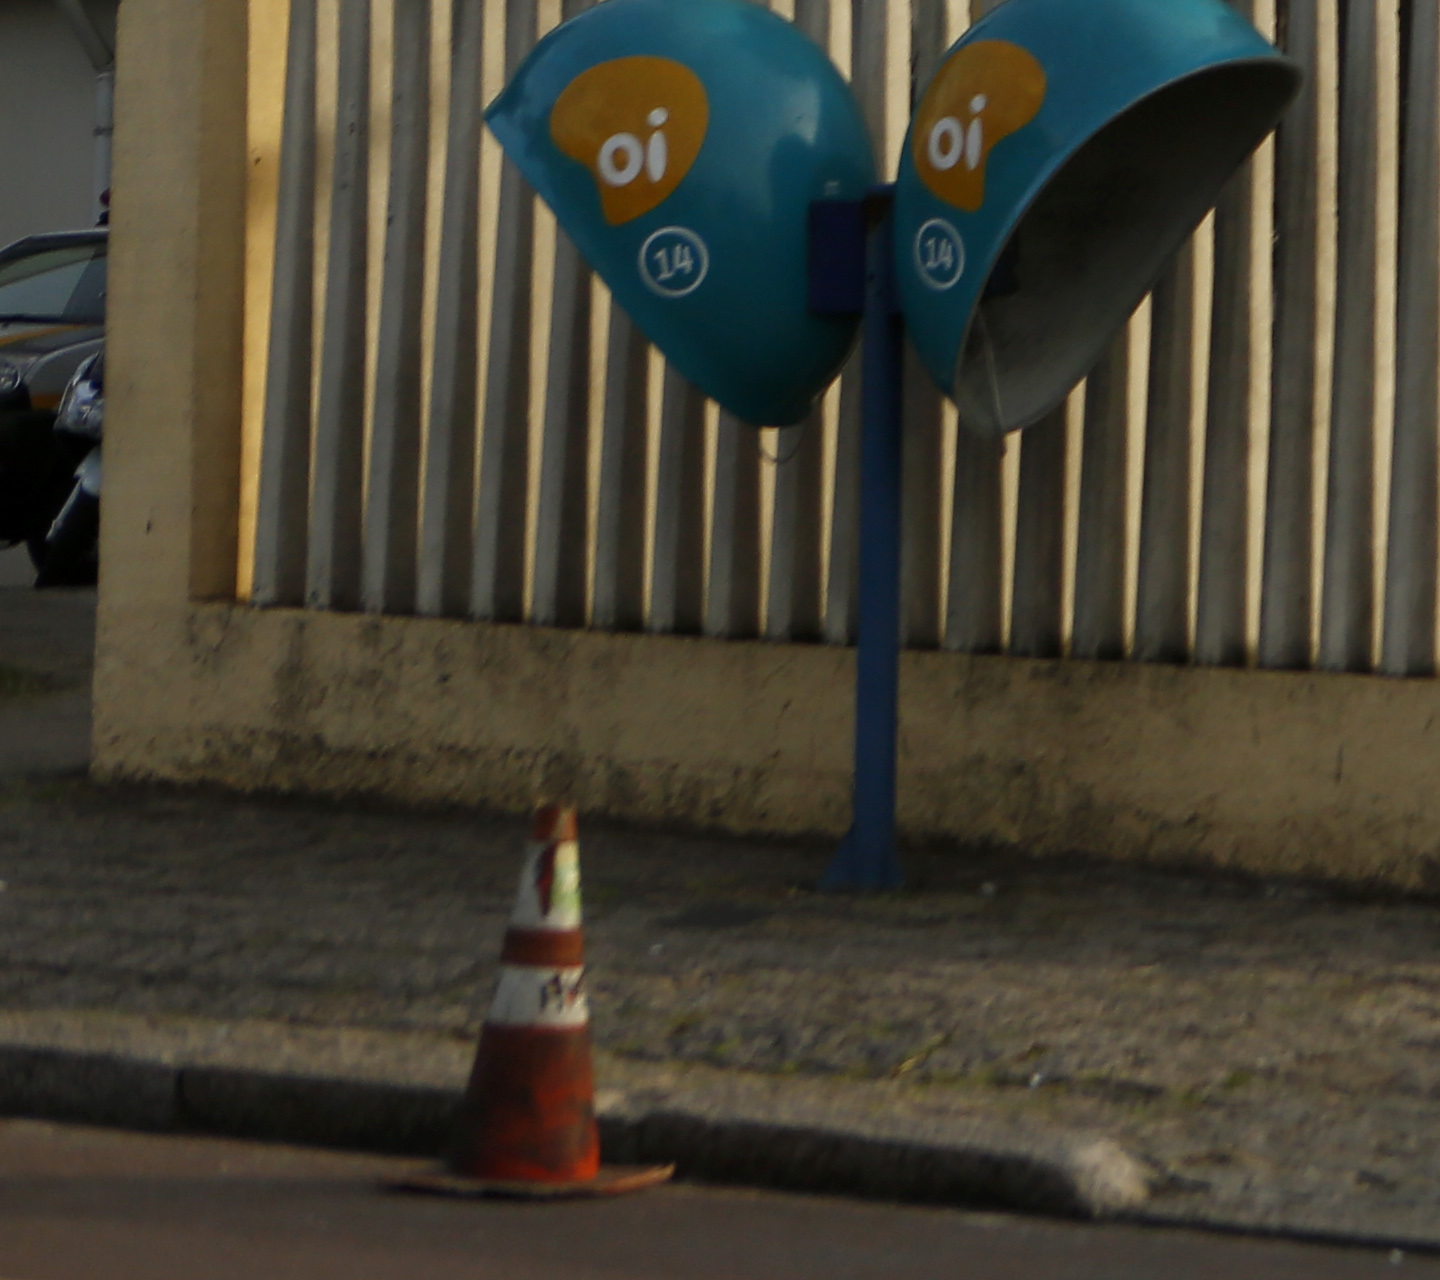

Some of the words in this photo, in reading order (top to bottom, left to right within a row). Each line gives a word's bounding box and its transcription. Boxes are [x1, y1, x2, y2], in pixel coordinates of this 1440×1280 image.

[597, 106, 669, 187] oi
[927, 93, 987, 172] oi
[652, 243, 695, 283] 14
[924, 236, 954, 272] 14
